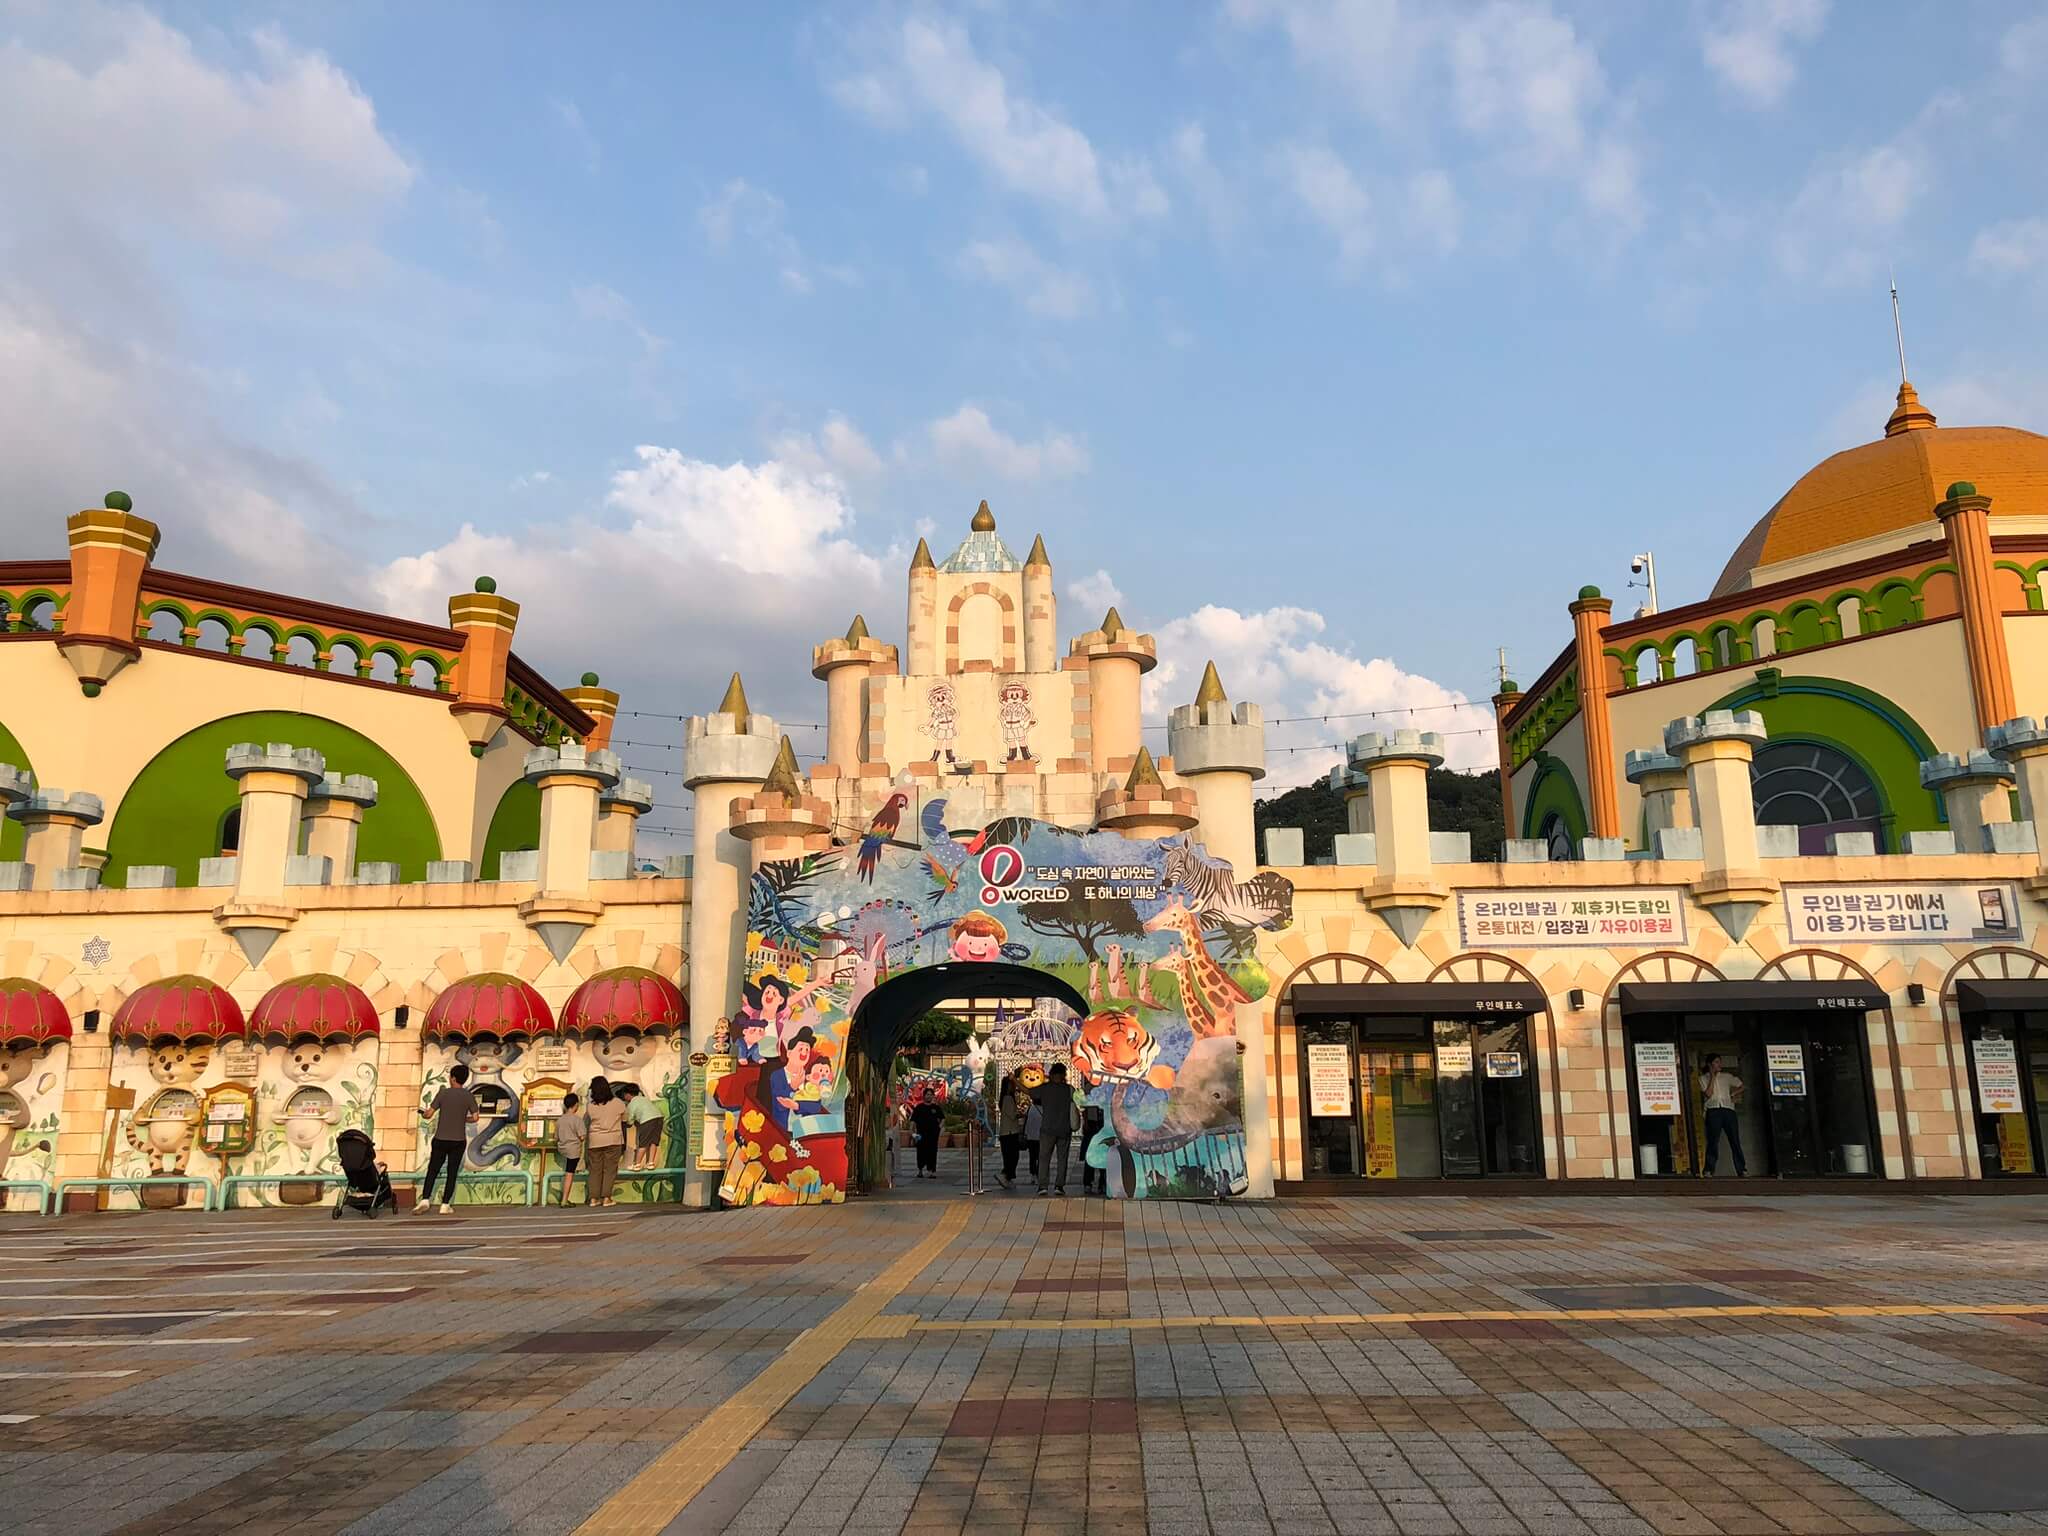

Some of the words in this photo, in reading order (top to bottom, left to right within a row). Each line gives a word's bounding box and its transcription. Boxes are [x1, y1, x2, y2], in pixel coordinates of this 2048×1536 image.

[1037, 867, 1060, 880] 도심
[1061, 867, 1073, 880] 속
[1075, 867, 1108, 880] 자연이
[1111, 867, 1155, 880] 살아있는
[1084, 886, 1096, 900] 또
[1098, 886, 1131, 900] 하나의
[1134, 886, 1157, 900] 세상
[1475, 901, 1557, 917] 온라인발권
[1571, 899, 1671, 915] 제휴카드할인
[1802, 893, 1945, 913] 무인발권기에서
[1476, 920, 1535, 936] 온통대전
[1545, 919, 1589, 935] 입장권
[1599, 918, 1673, 934] 자유이용권
[1806, 914, 1949, 933] 이용가능합니다
[1475, 1000, 1524, 1011] 무인매표소
[1817, 998, 1867, 1008] 무인매표소
